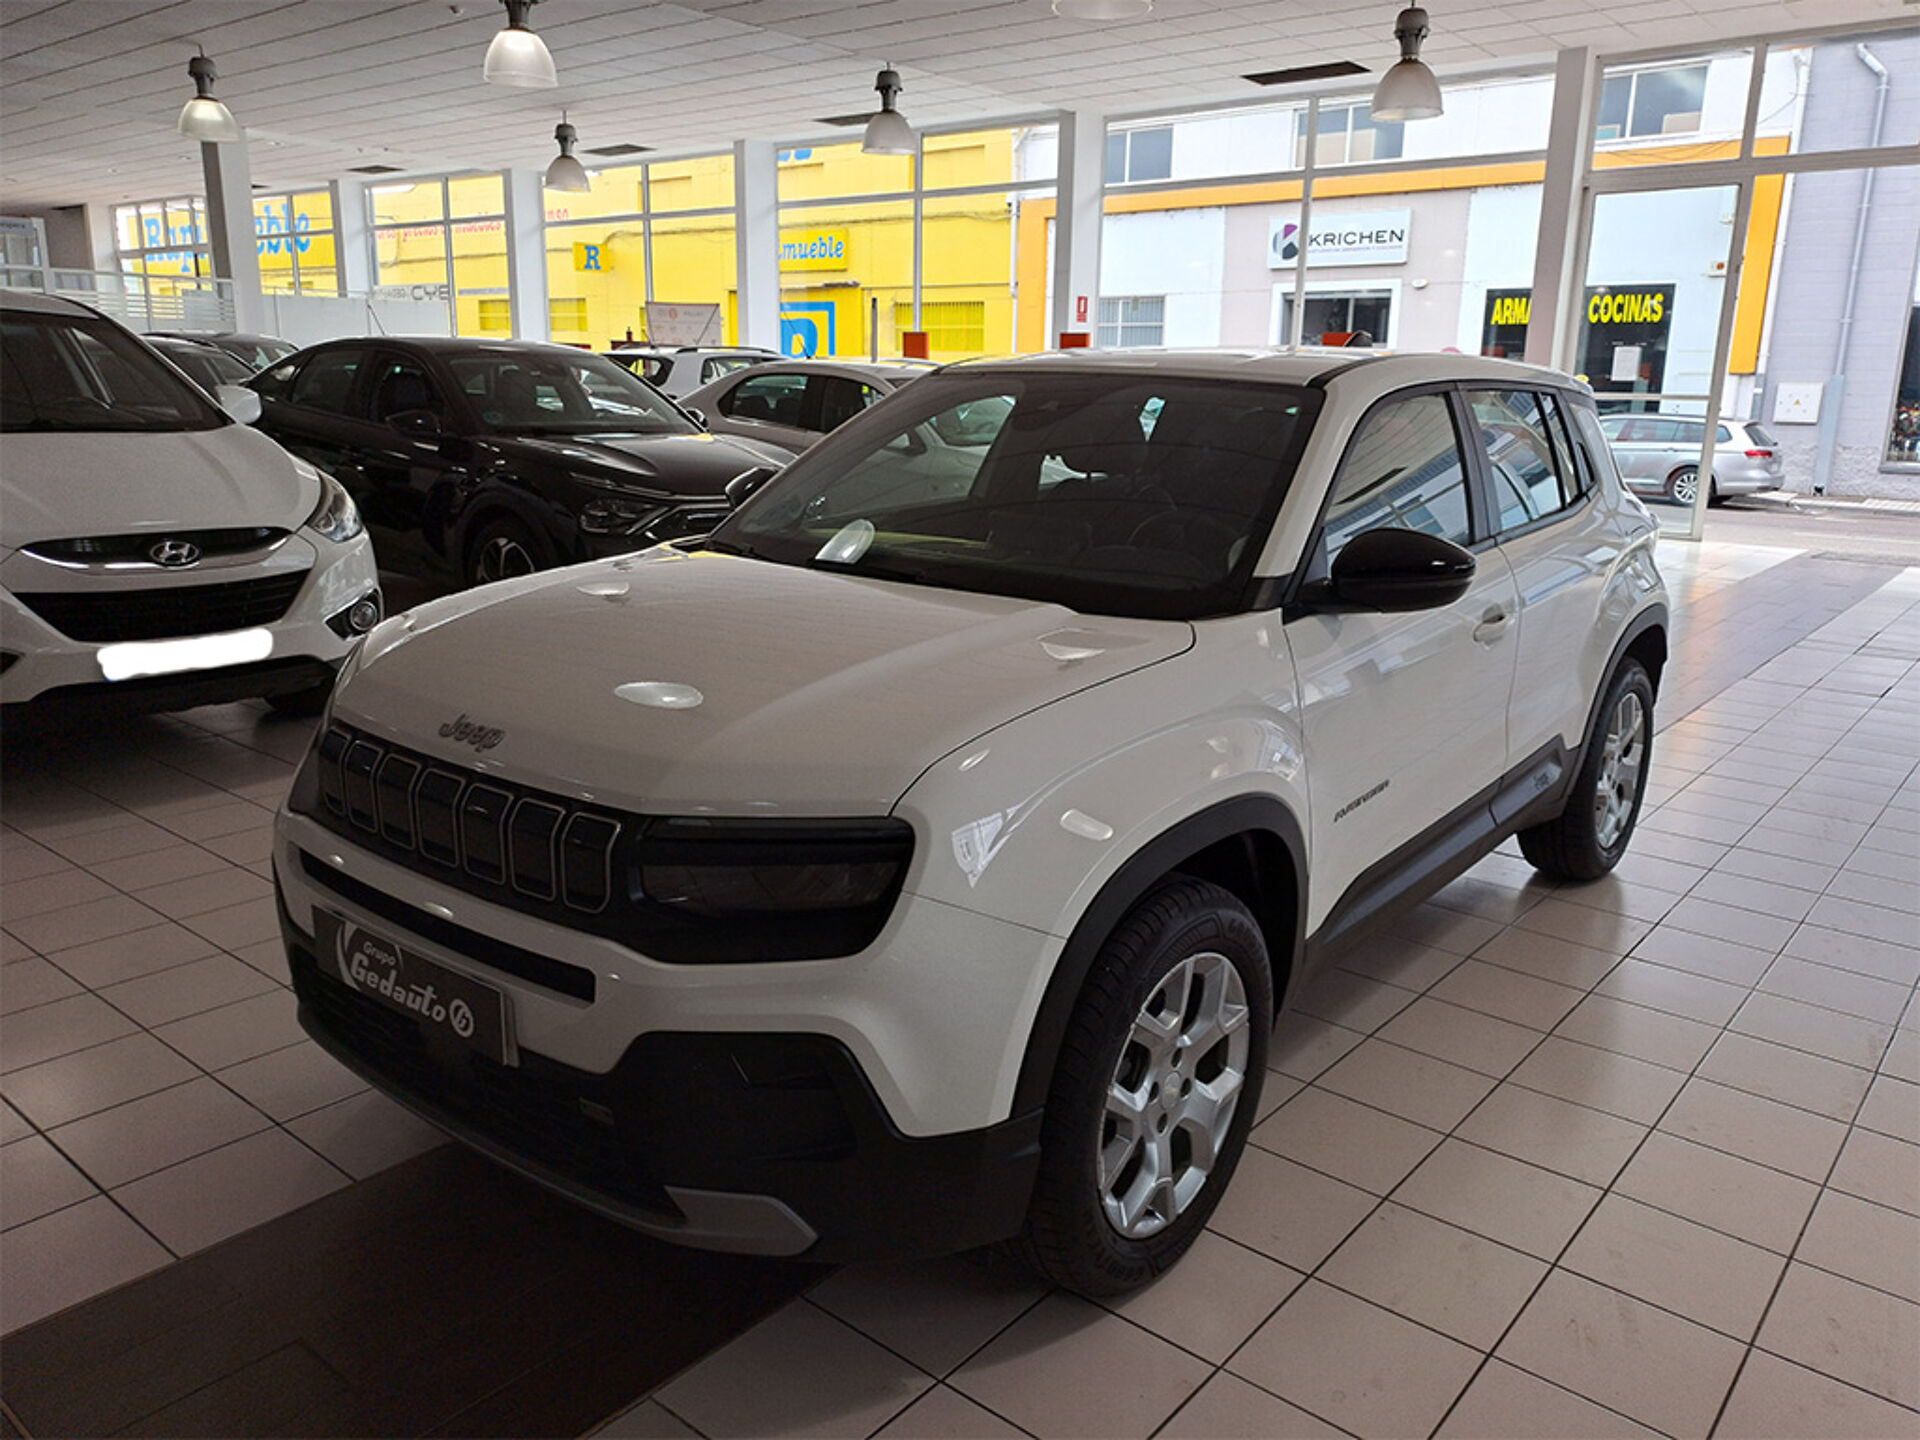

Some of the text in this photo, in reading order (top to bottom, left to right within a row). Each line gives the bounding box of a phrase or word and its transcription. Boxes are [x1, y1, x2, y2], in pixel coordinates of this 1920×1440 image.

[779, 236, 844, 259] mueble
[1308, 229, 1404, 246] KRICHEN
[584, 245, 601, 270] R
[1588, 293, 1664, 323] COCINAS
[439, 713, 505, 752] Jeep
[363, 941, 396, 966] Grupo
[351, 952, 446, 1022] Gedauto
